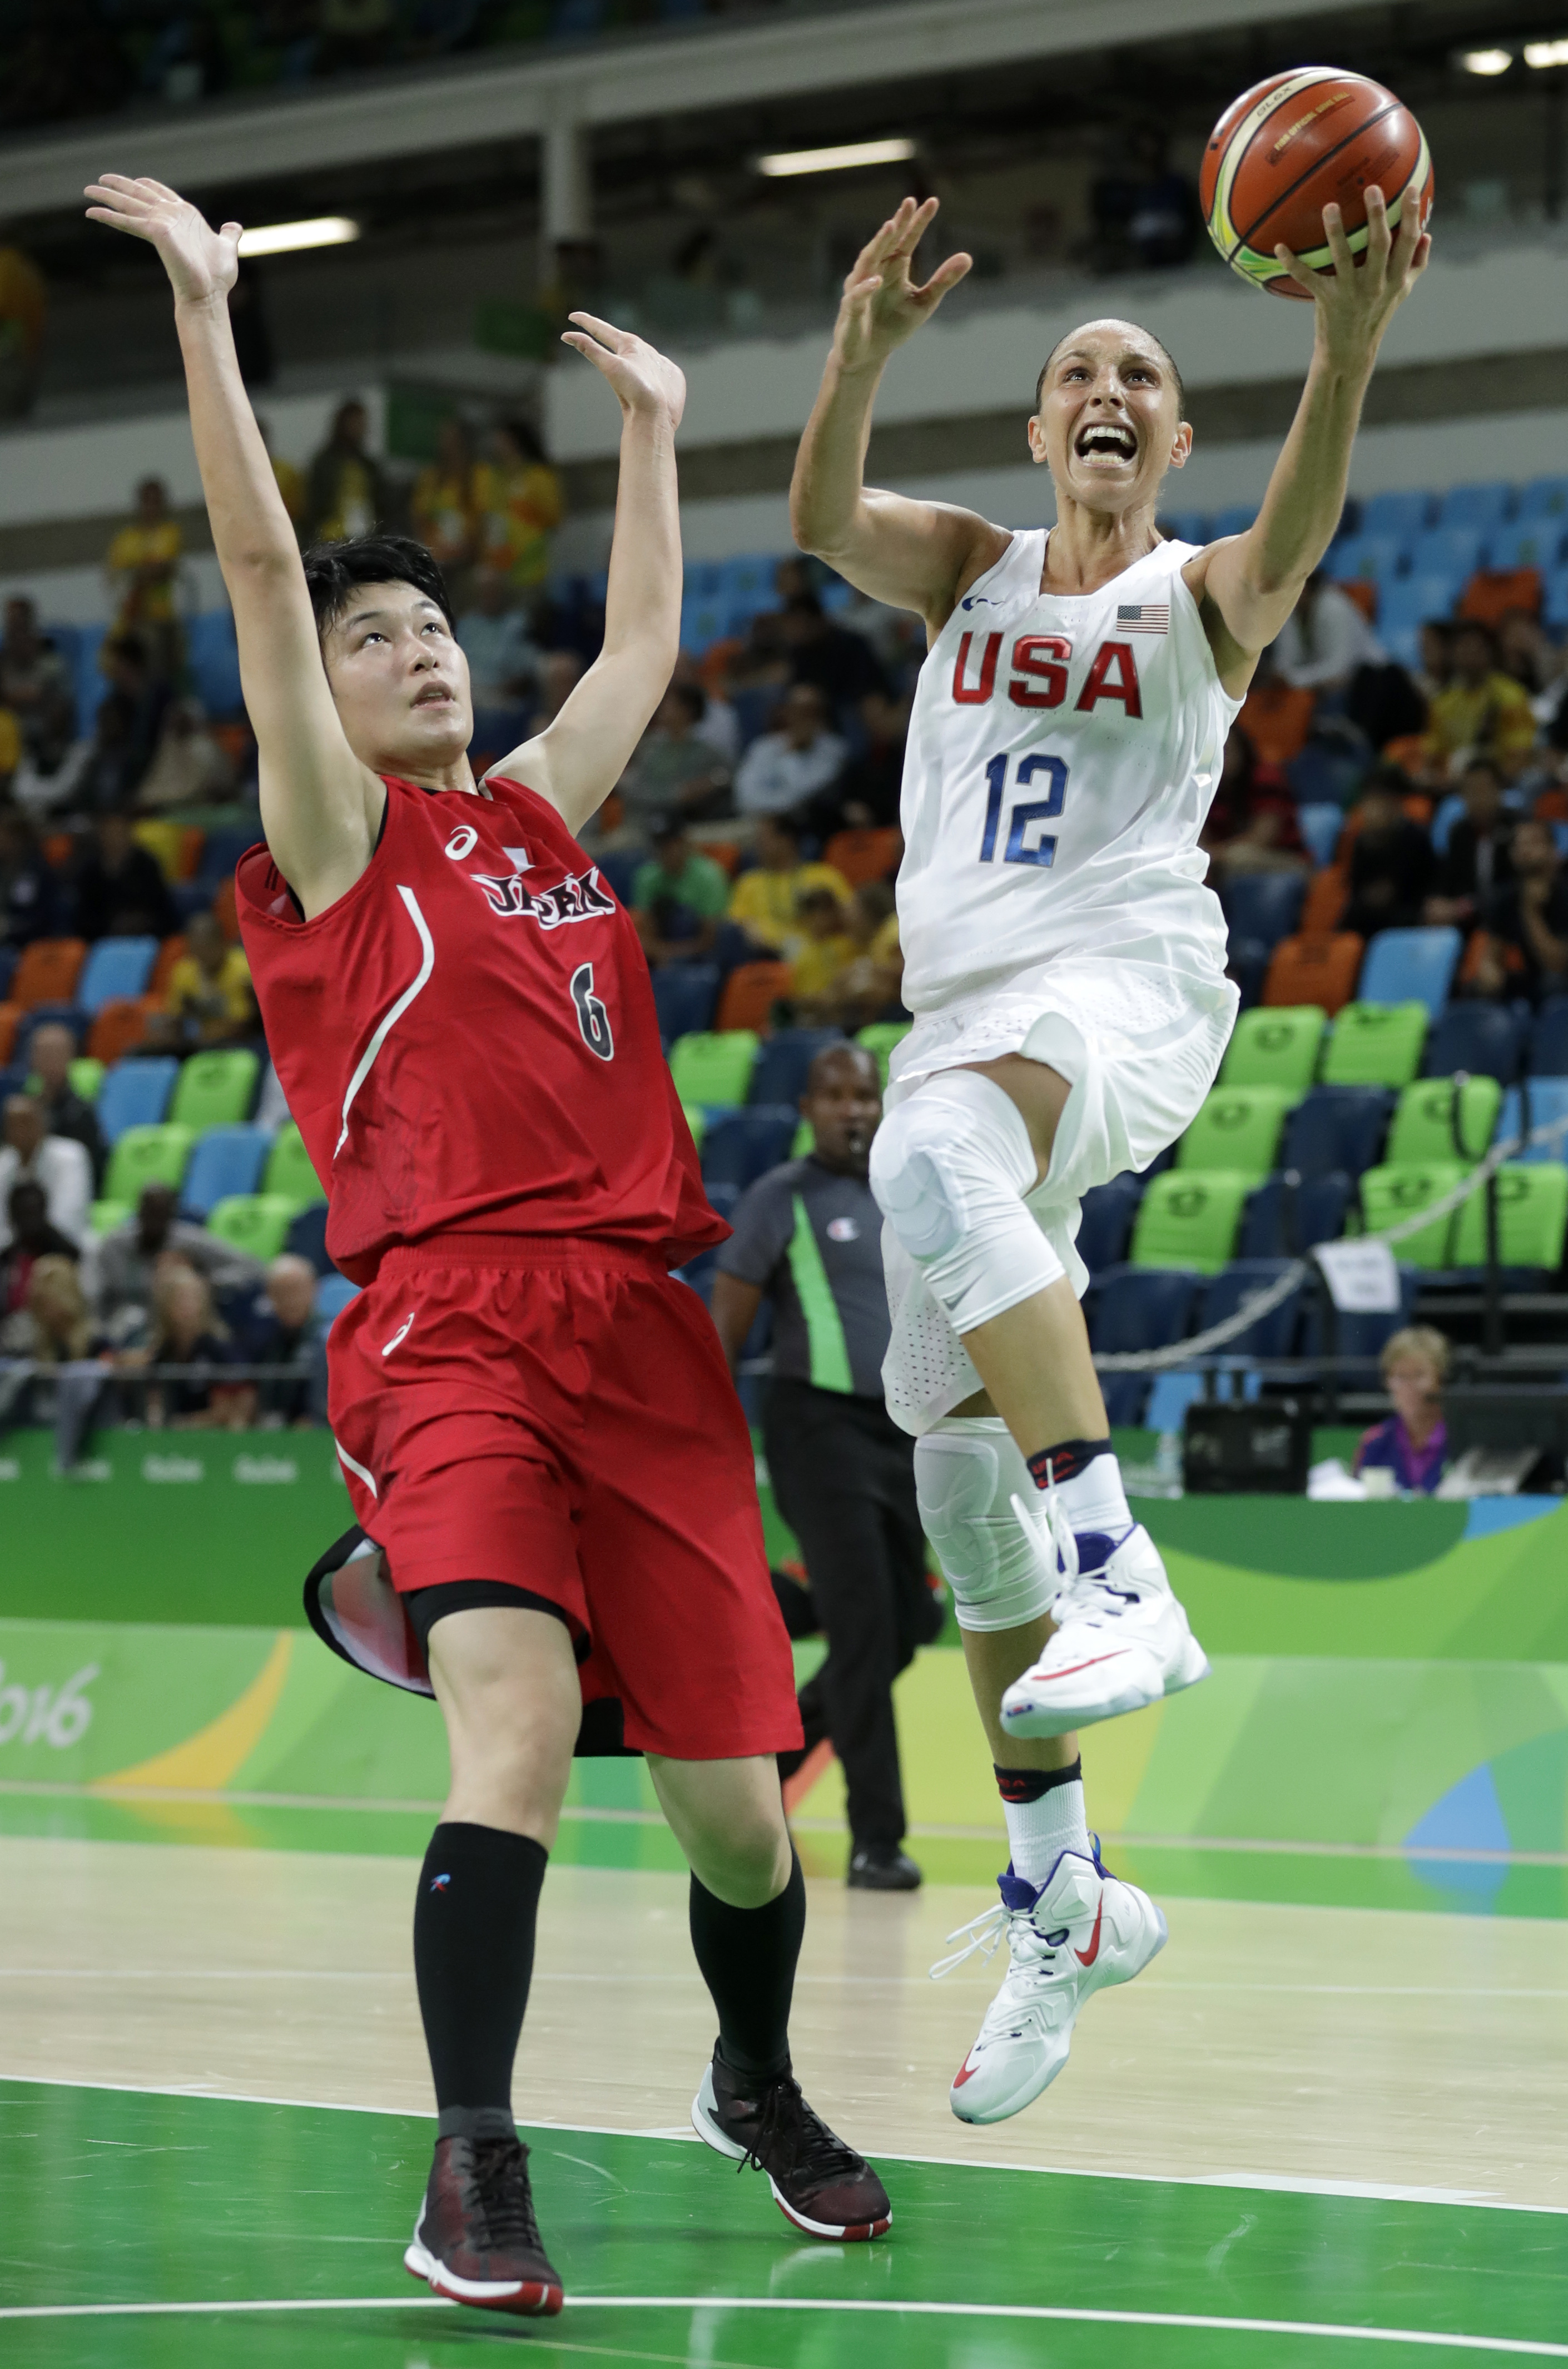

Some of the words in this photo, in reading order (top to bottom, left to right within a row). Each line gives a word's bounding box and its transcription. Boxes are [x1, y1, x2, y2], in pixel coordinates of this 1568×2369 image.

[952, 631, 1143, 719] USA
[979, 752, 1070, 868] 12
[569, 962, 614, 1061] 6
